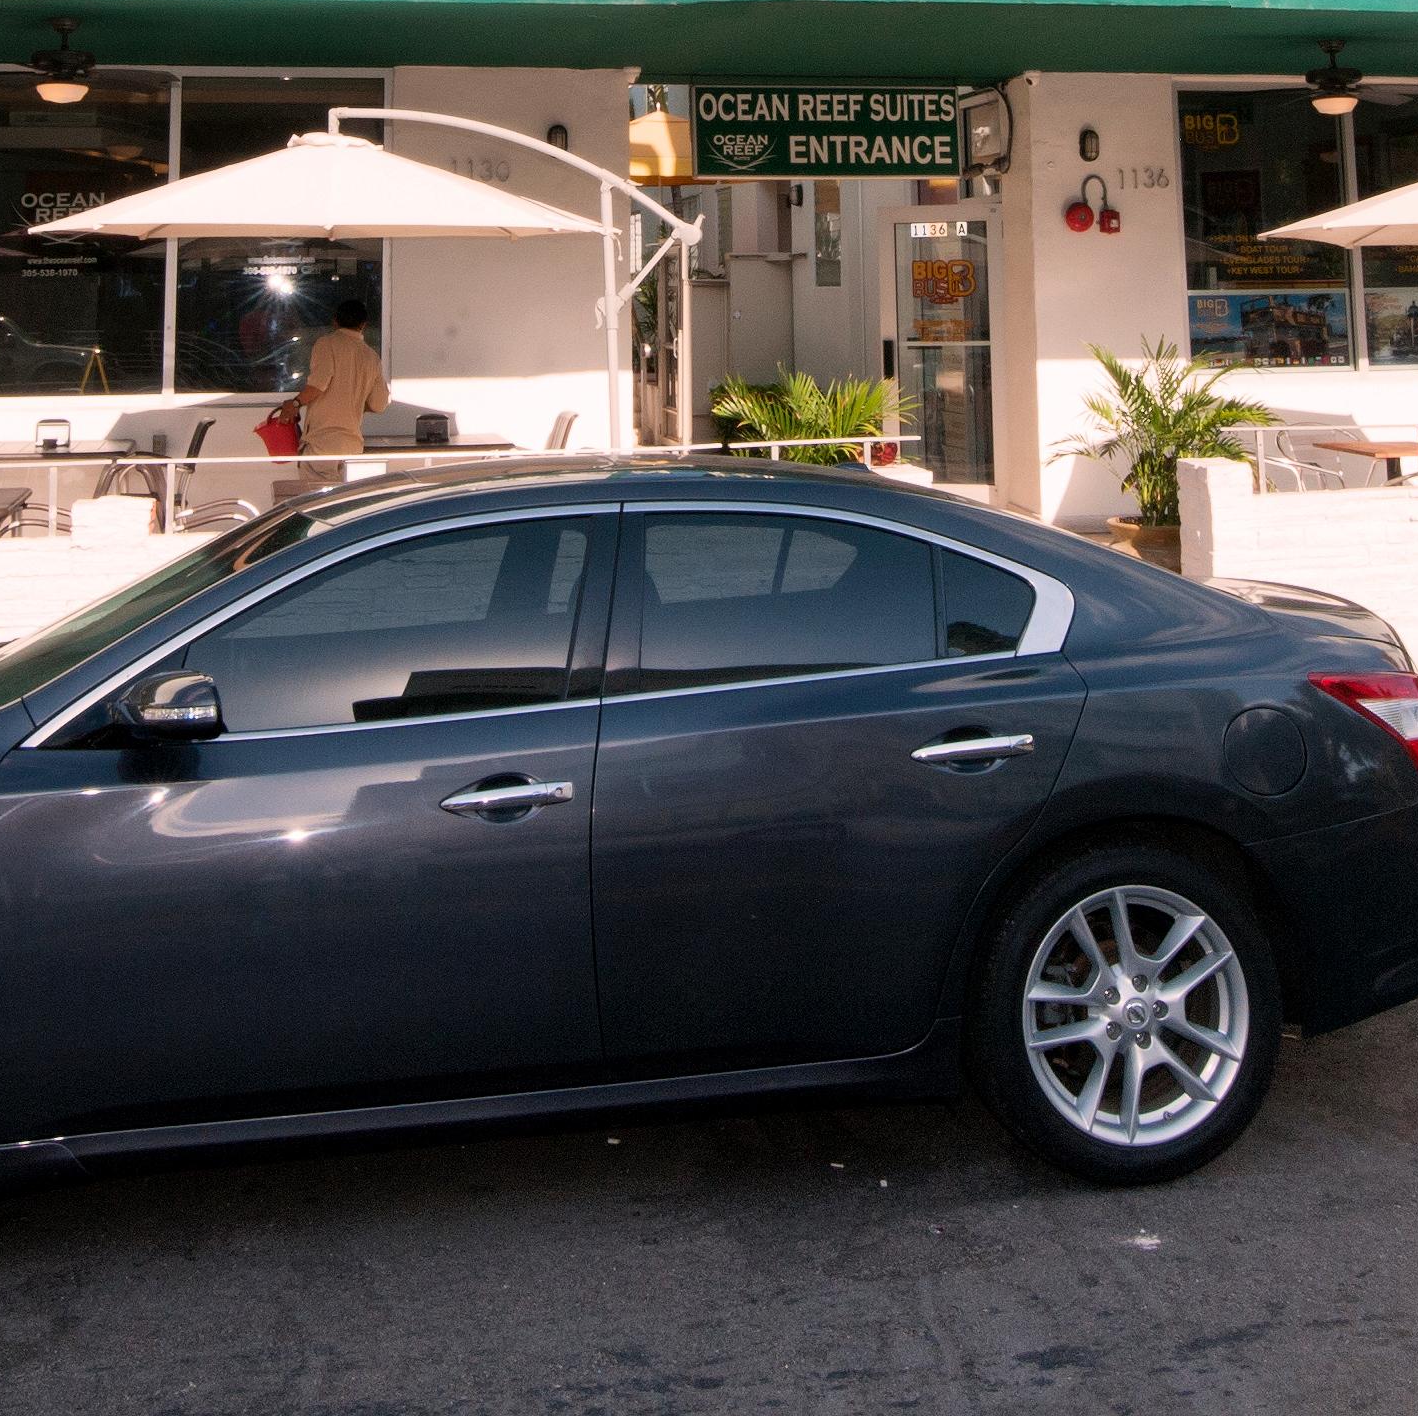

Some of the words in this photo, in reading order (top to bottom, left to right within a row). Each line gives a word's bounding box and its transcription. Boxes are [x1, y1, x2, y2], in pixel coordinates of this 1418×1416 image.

[699, 93, 790, 122] OCEAN
[797, 93, 864, 122] REEF
[869, 93, 955, 122] SUITES
[1184, 114, 1214, 130] BIG
[713, 135, 769, 146] OCEAN
[723, 145, 763, 156] REEF
[789, 135, 953, 165] ENTRANCE
[1119, 166, 1169, 190] 1136
[21, 192, 105, 208] OCEAN
[914, 224, 946, 237] 1136
[958, 223, 966, 235] A
[912, 260, 948, 280] BIG
[913, 279, 949, 297] BUS
